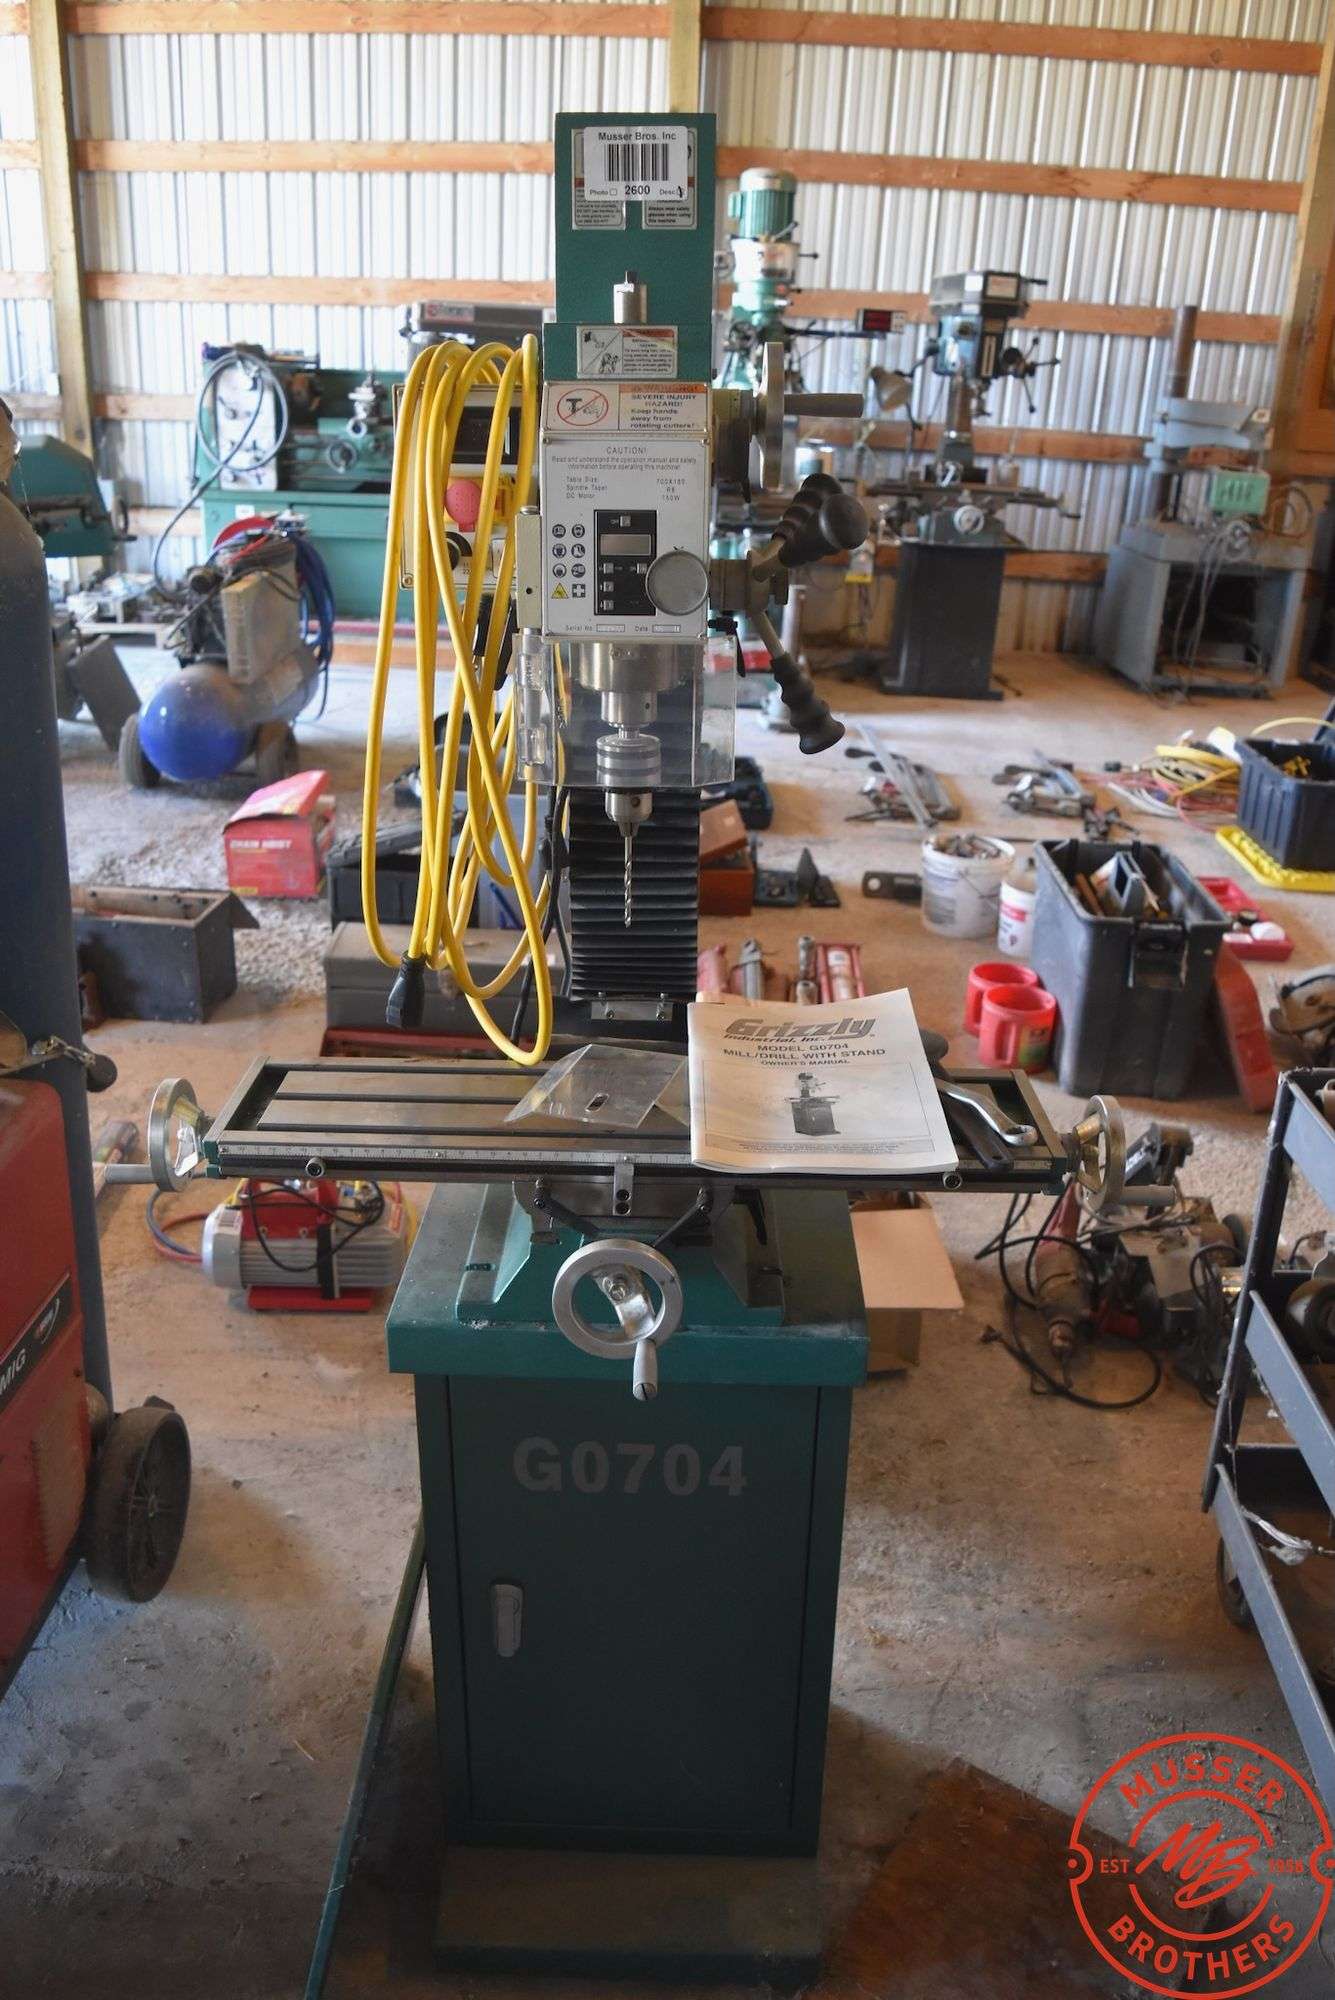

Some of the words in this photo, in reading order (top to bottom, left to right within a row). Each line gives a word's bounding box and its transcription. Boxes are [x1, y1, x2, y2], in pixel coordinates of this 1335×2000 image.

[598, 132, 632, 141] Musser
[662, 131, 677, 140] Inc
[624, 185, 650, 195] 2600
[725, 1018, 876, 1040] Grizzly
[809, 1043, 849, 1051] G0704
[723, 1049, 800, 1059] MILL/DRILL
[841, 1049, 886, 1058] STAND
[0, 1348, 26, 1395] MIG
[513, 1436, 747, 1496] G0704
